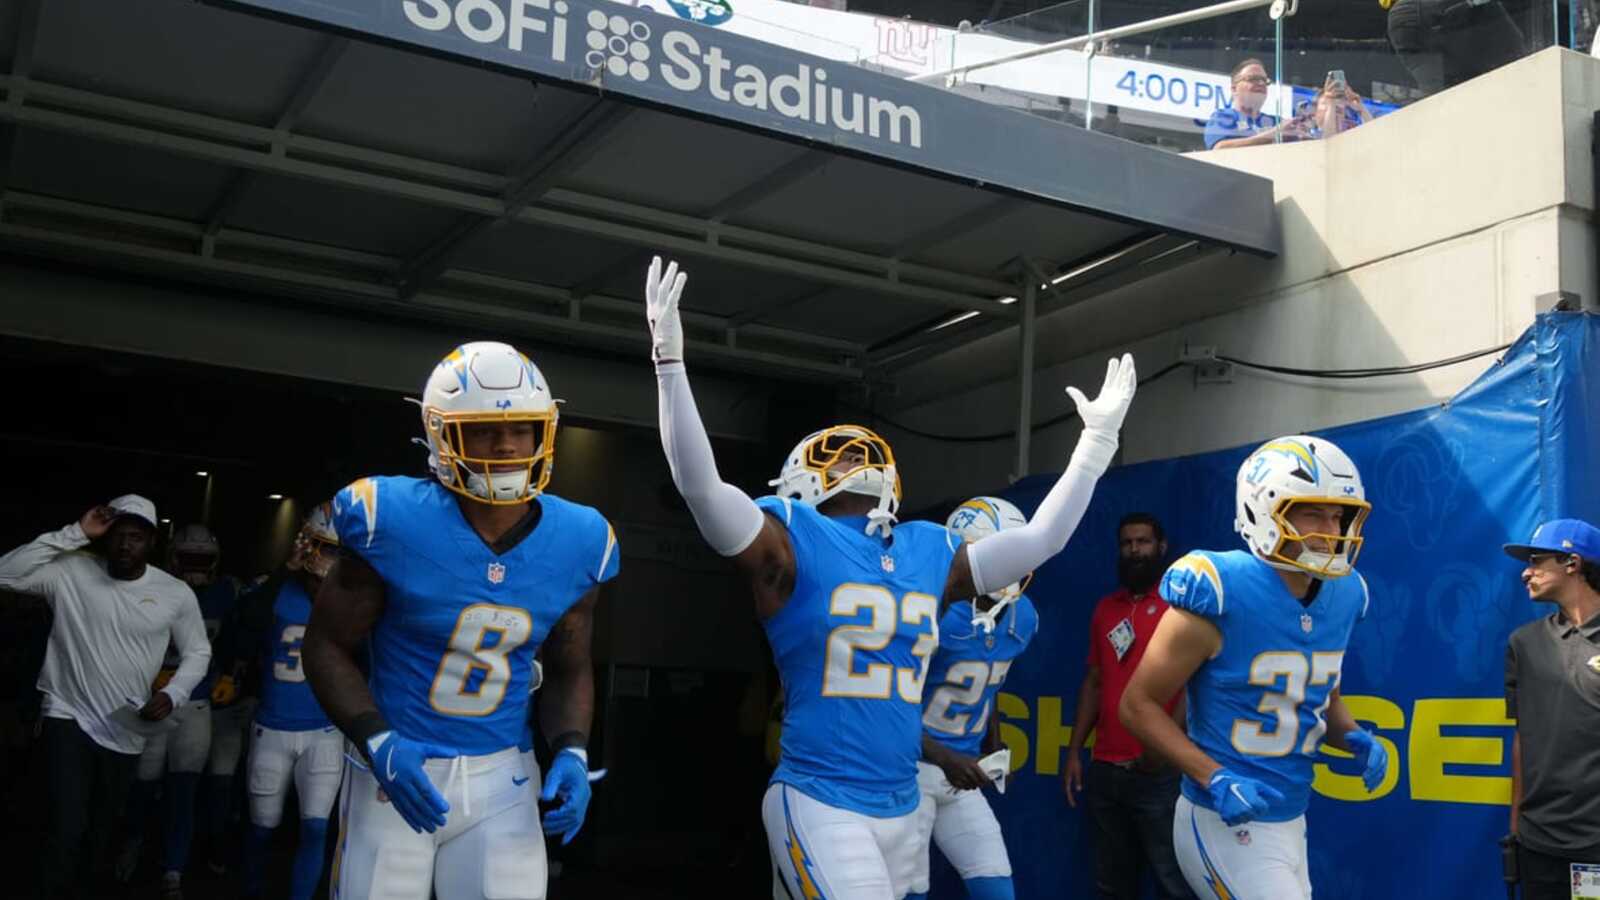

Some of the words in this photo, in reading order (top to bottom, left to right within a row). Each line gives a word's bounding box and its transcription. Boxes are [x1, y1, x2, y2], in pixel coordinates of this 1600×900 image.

[659, 31, 922, 148] Stadium
[1116, 70, 1188, 104] 4:00
[429, 602, 533, 718] 8
[821, 582, 940, 704] 23
[922, 660, 1013, 736] 27
[1231, 651, 1346, 758] 37
